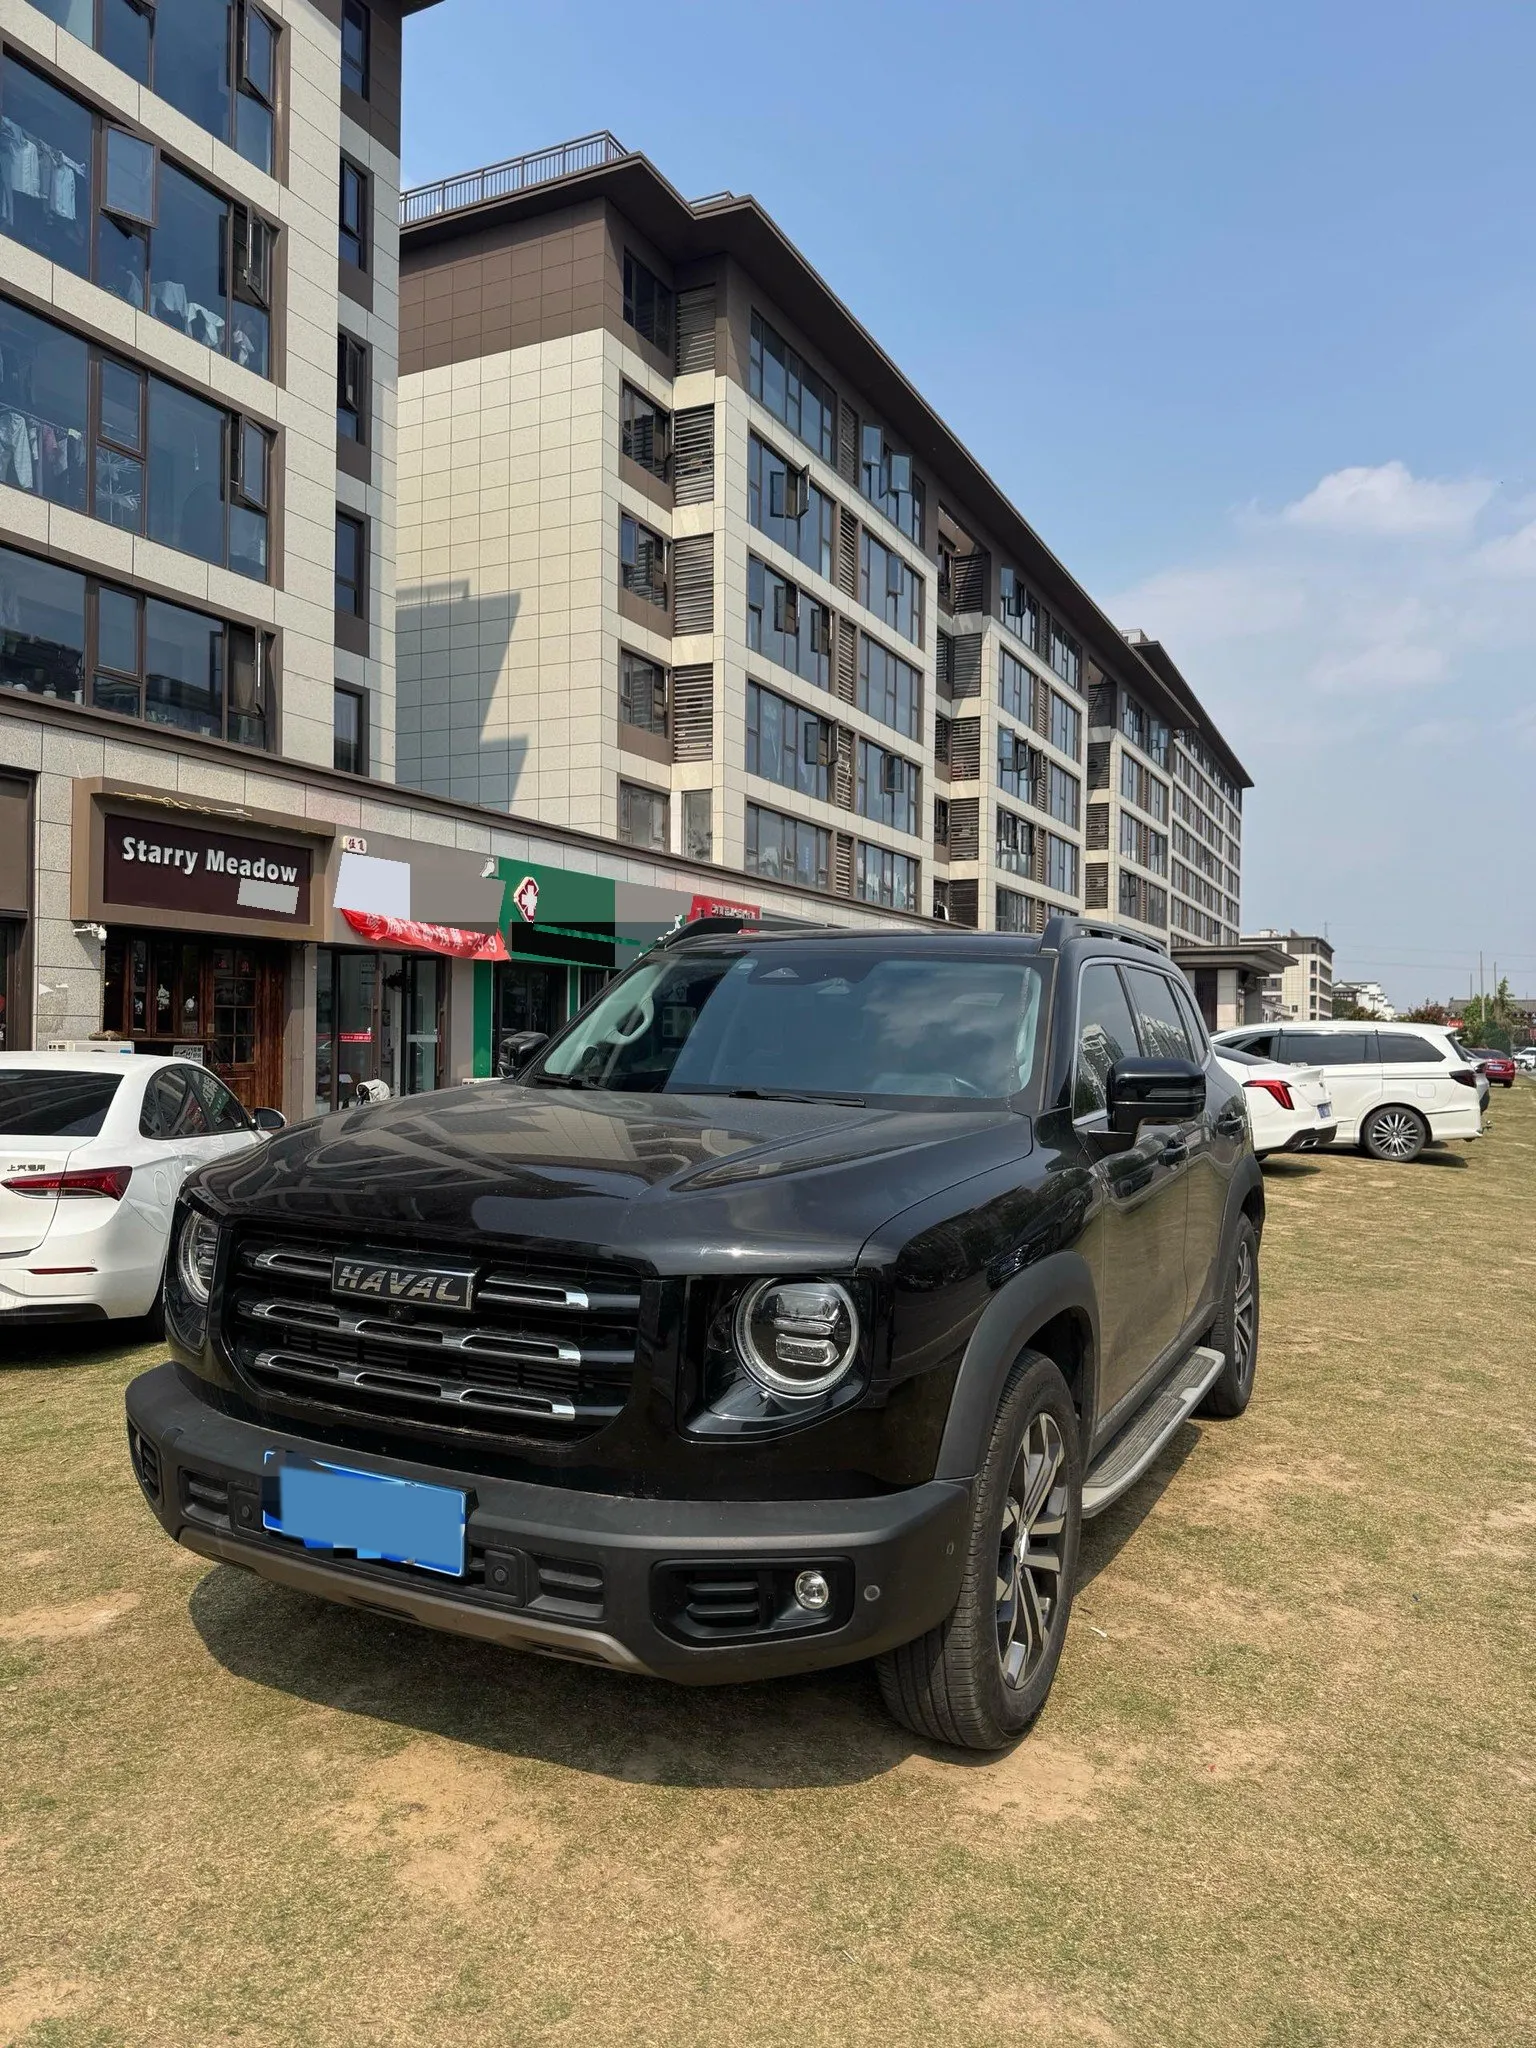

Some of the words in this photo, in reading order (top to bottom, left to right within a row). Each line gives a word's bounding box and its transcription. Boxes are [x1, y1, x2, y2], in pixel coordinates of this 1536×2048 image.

[122, 836, 199, 876] Starry
[205, 848, 298, 884] Meadow
[337, 1265, 461, 1302] HAVAL
